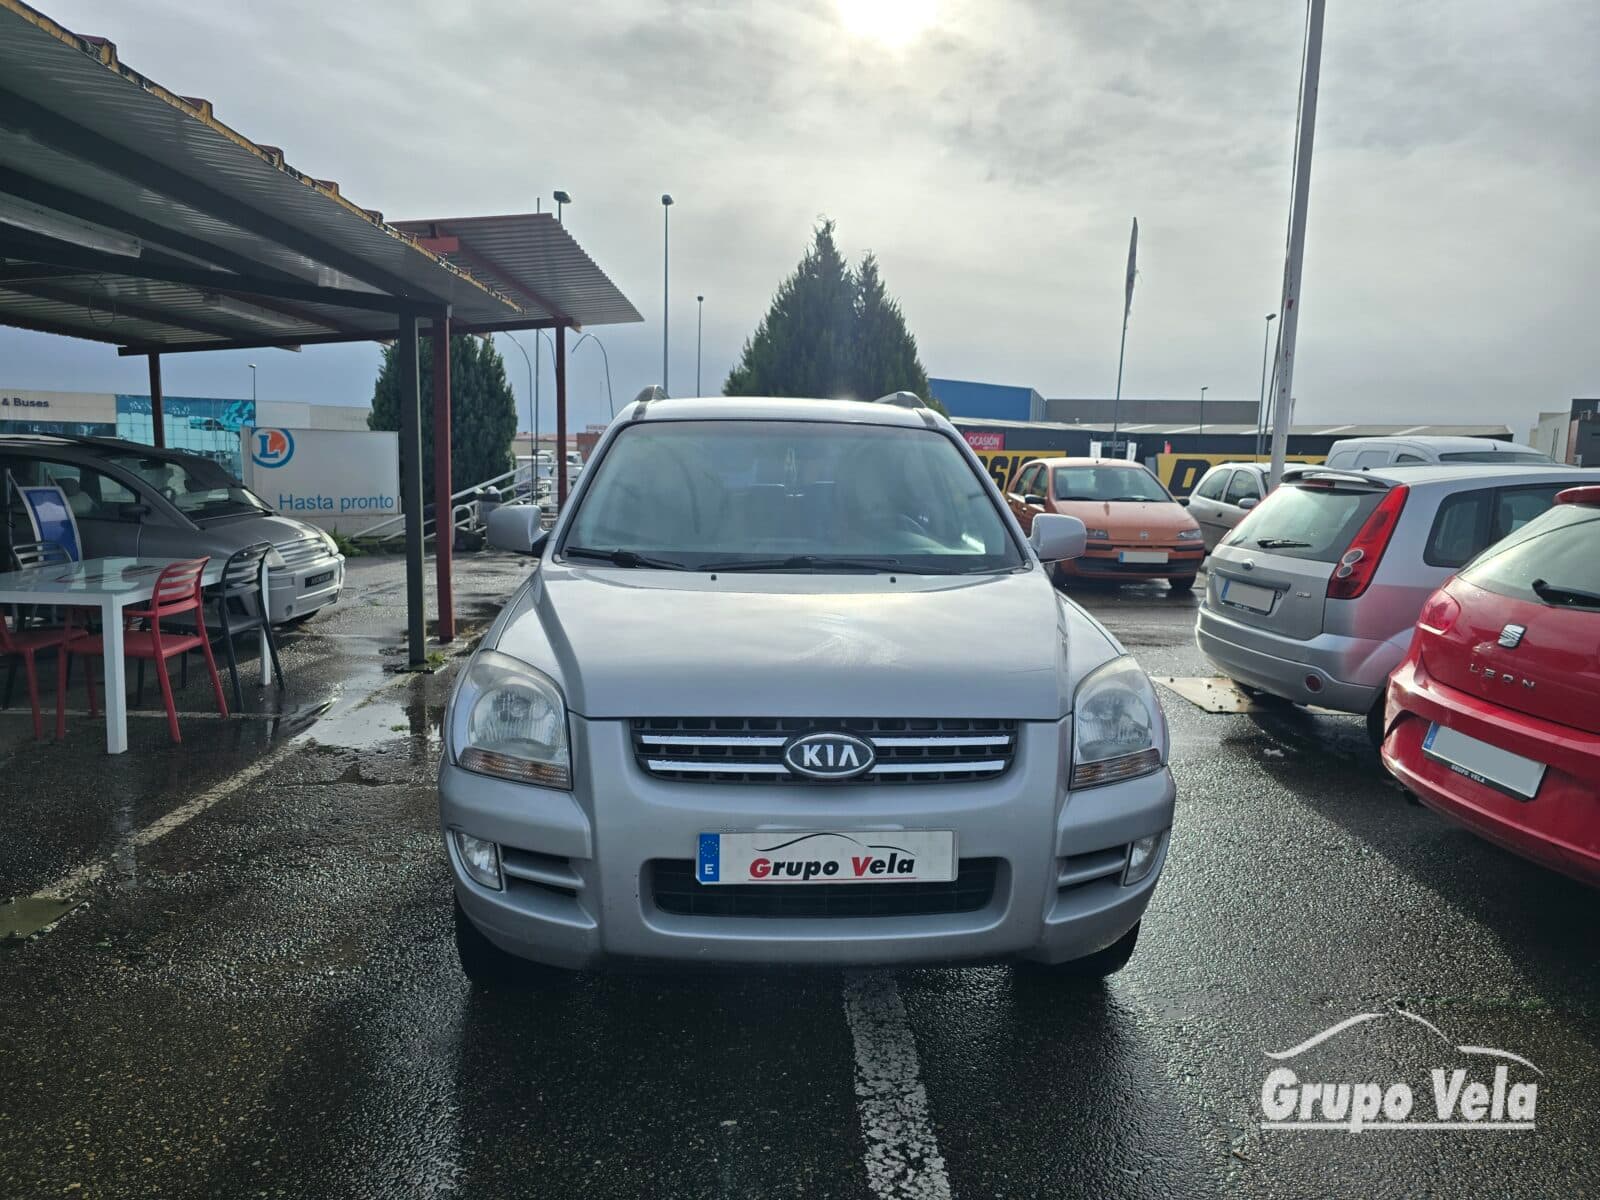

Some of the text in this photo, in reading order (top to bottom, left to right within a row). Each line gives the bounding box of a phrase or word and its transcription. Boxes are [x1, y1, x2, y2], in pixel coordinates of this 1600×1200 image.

[13, 397, 49, 408] Buses
[279, 493, 394, 512] Hasta pronto
[1469, 663, 1535, 688] LEON
[802, 744, 860, 767] KIA
[704, 863, 715, 875] E
[750, 852, 915, 881] Grupo Vela
